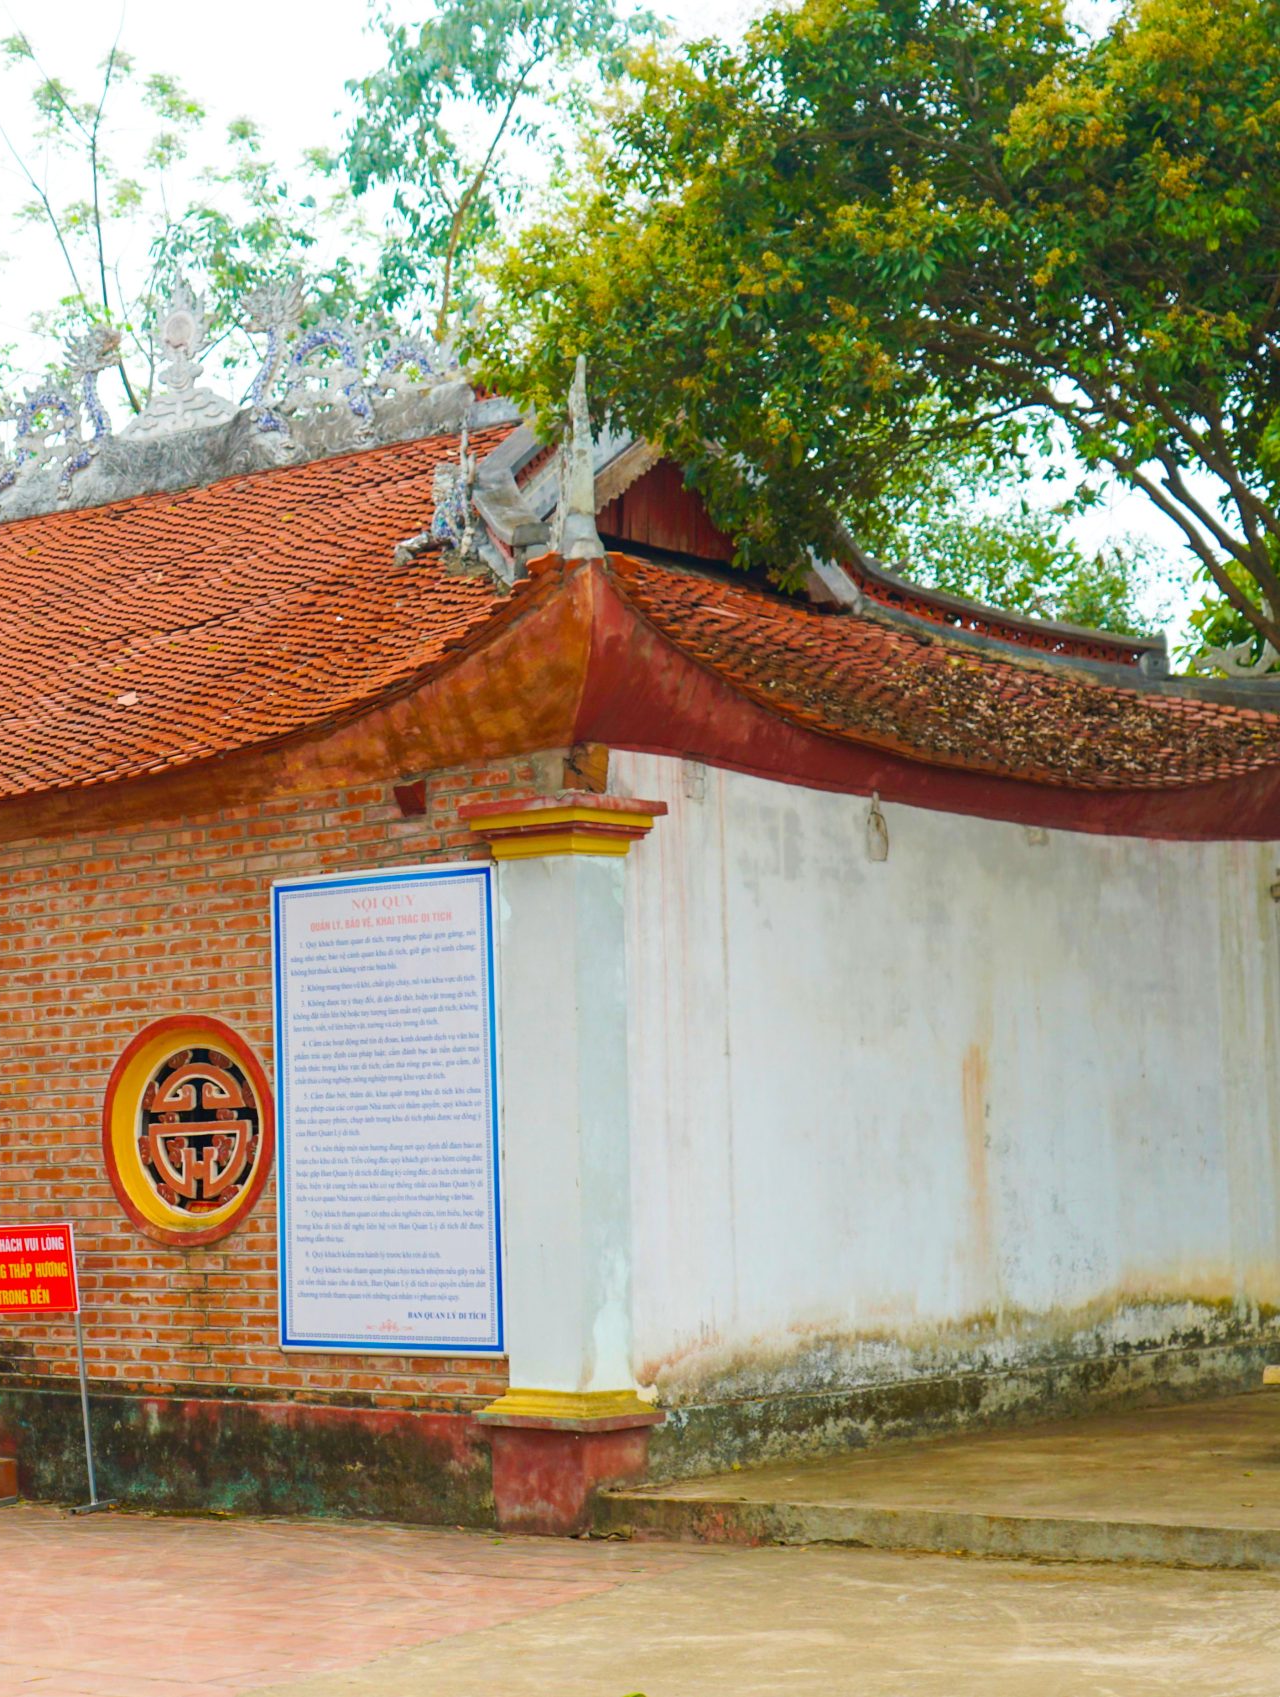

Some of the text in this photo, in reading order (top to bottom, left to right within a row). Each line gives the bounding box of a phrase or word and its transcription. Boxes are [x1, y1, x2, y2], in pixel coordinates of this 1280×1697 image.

[24, 1237, 39, 1251] VUI
[41, 1233, 65, 1251] LÒNG
[8, 1257, 32, 1278] THẮP
[35, 1260, 68, 1278] HƯƠNG
